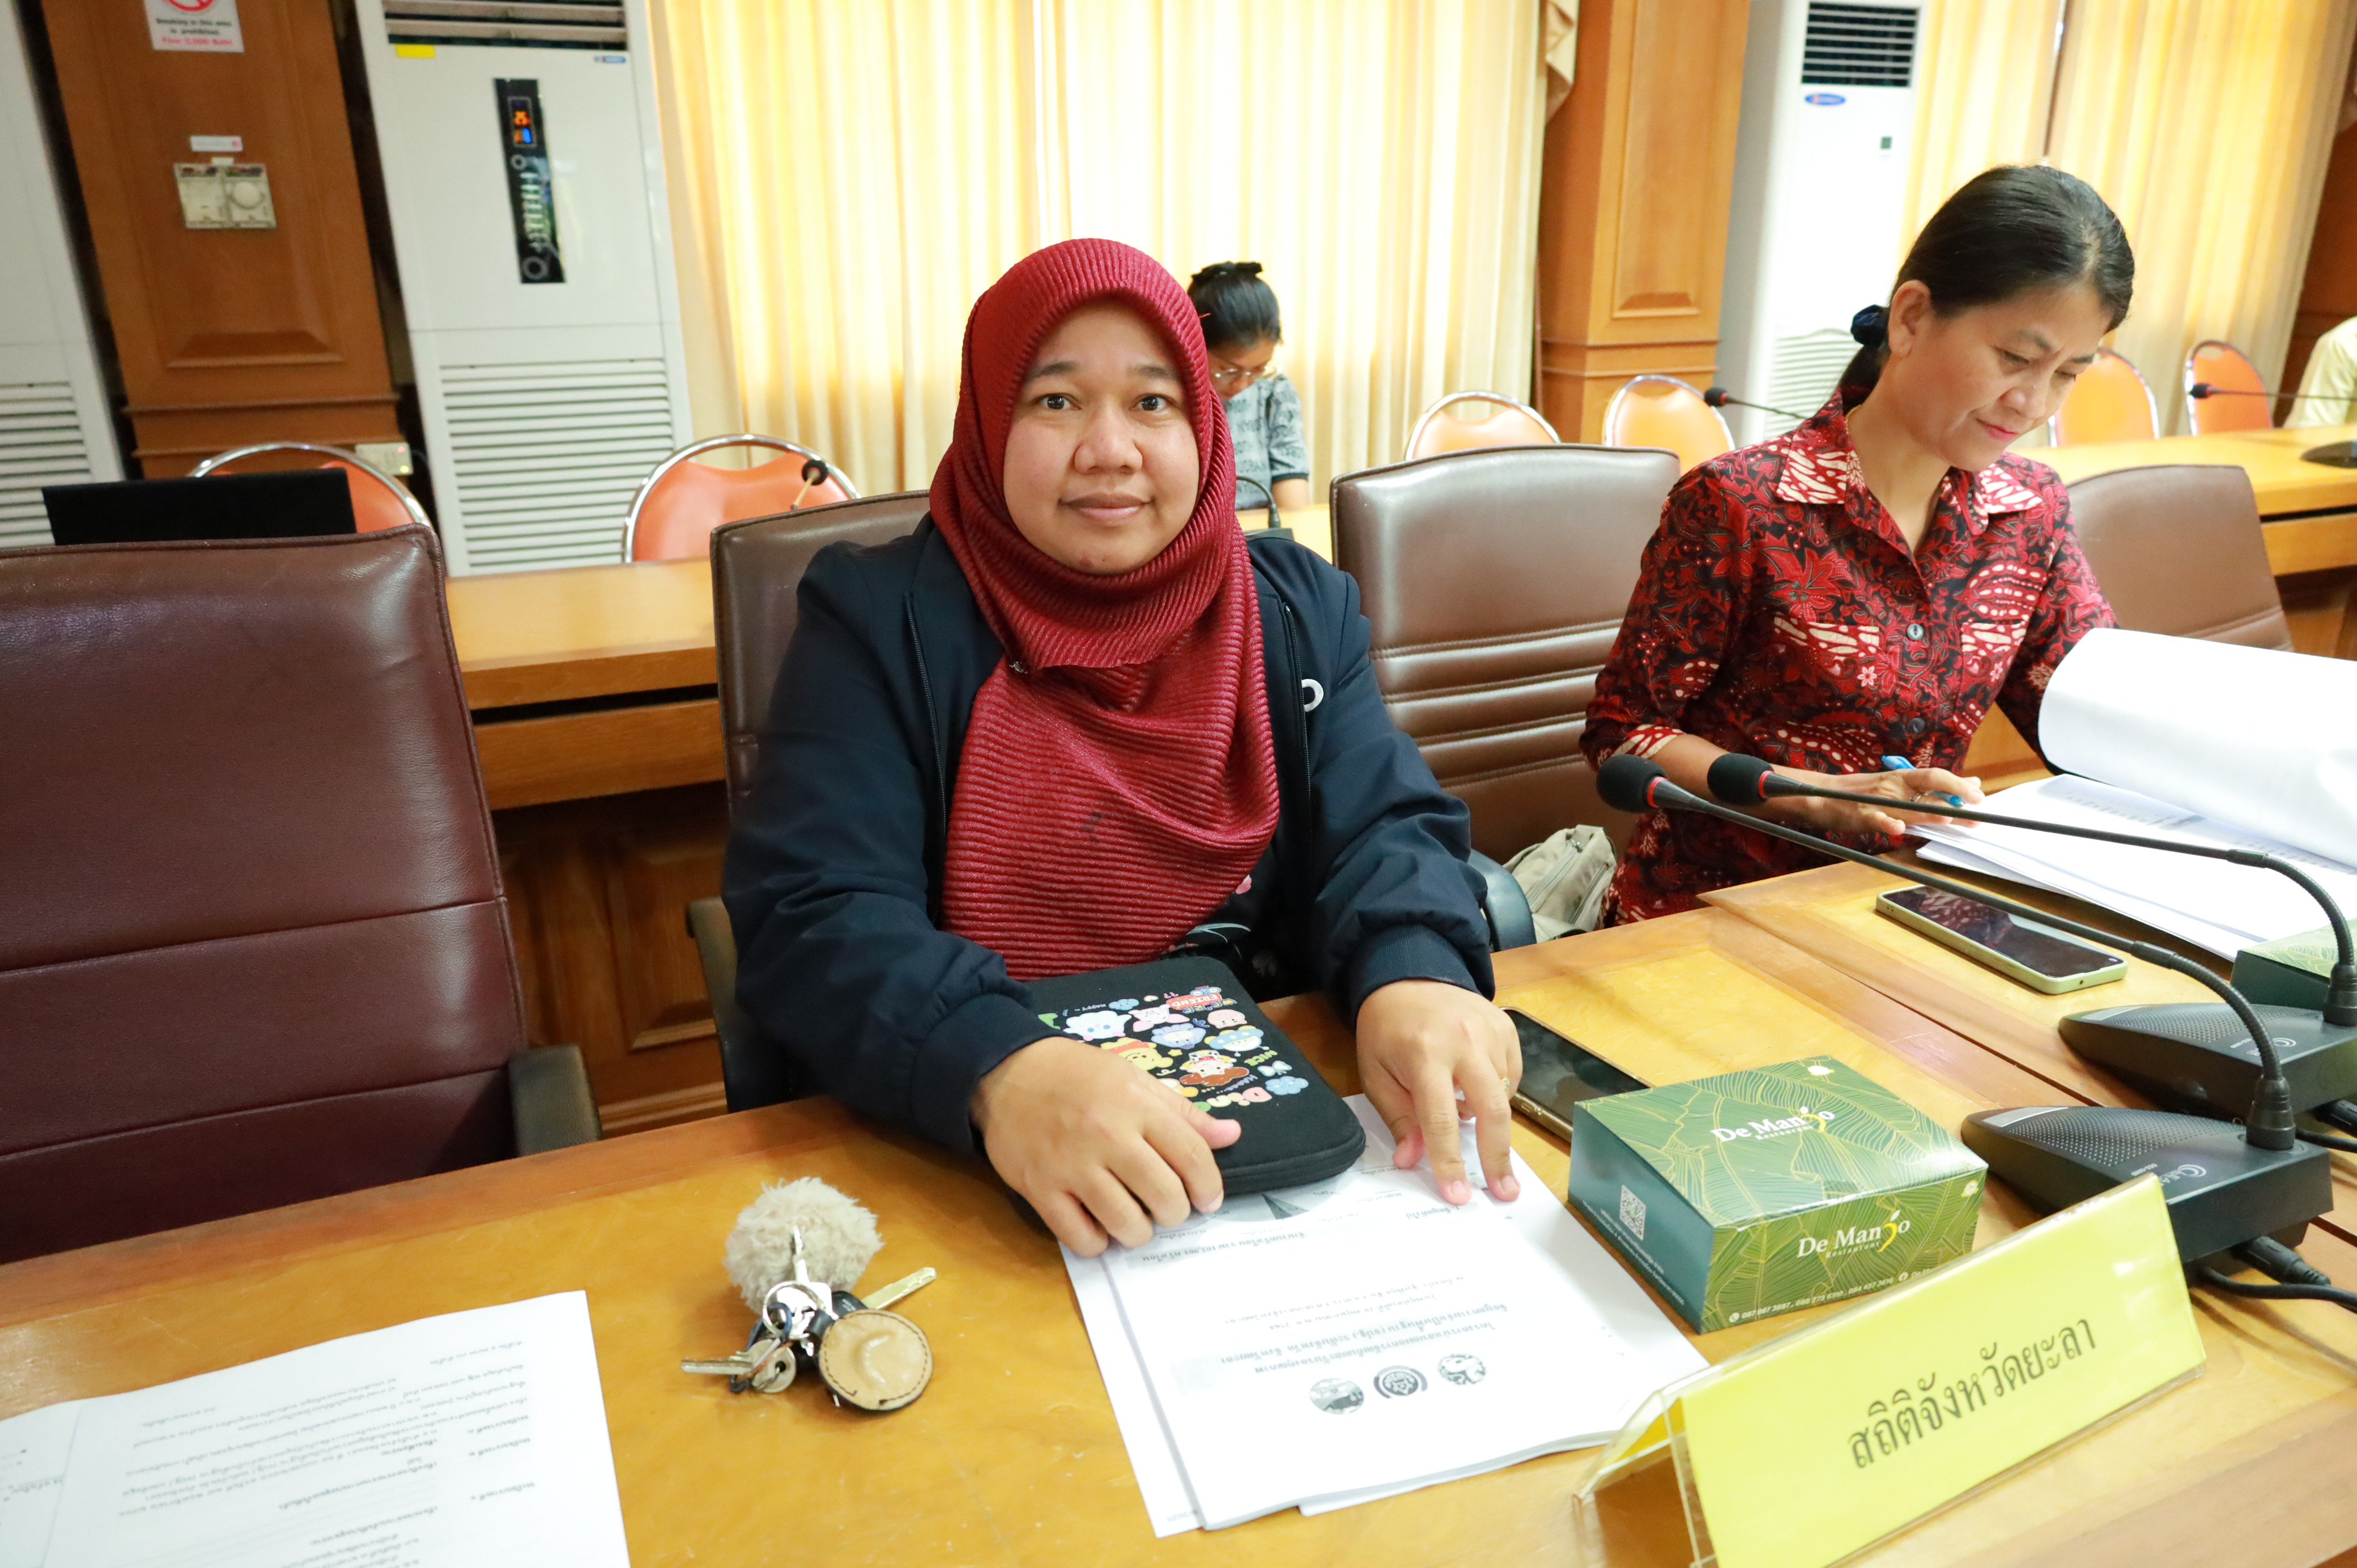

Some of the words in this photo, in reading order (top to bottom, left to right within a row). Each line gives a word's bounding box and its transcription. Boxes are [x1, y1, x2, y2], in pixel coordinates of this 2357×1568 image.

[1083, 1003, 1107, 1012] HAPPY
[1171, 994, 1222, 1008] FRIEND
[1245, 1050, 1278, 1066] NICE
[1711, 1126, 1751, 1144] De
[1797, 1236, 1828, 1258] De
[1825, 1241, 1881, 1259] Restaurant
[1848, 1319, 2096, 1468] สถิติจังหวัดยะลา
